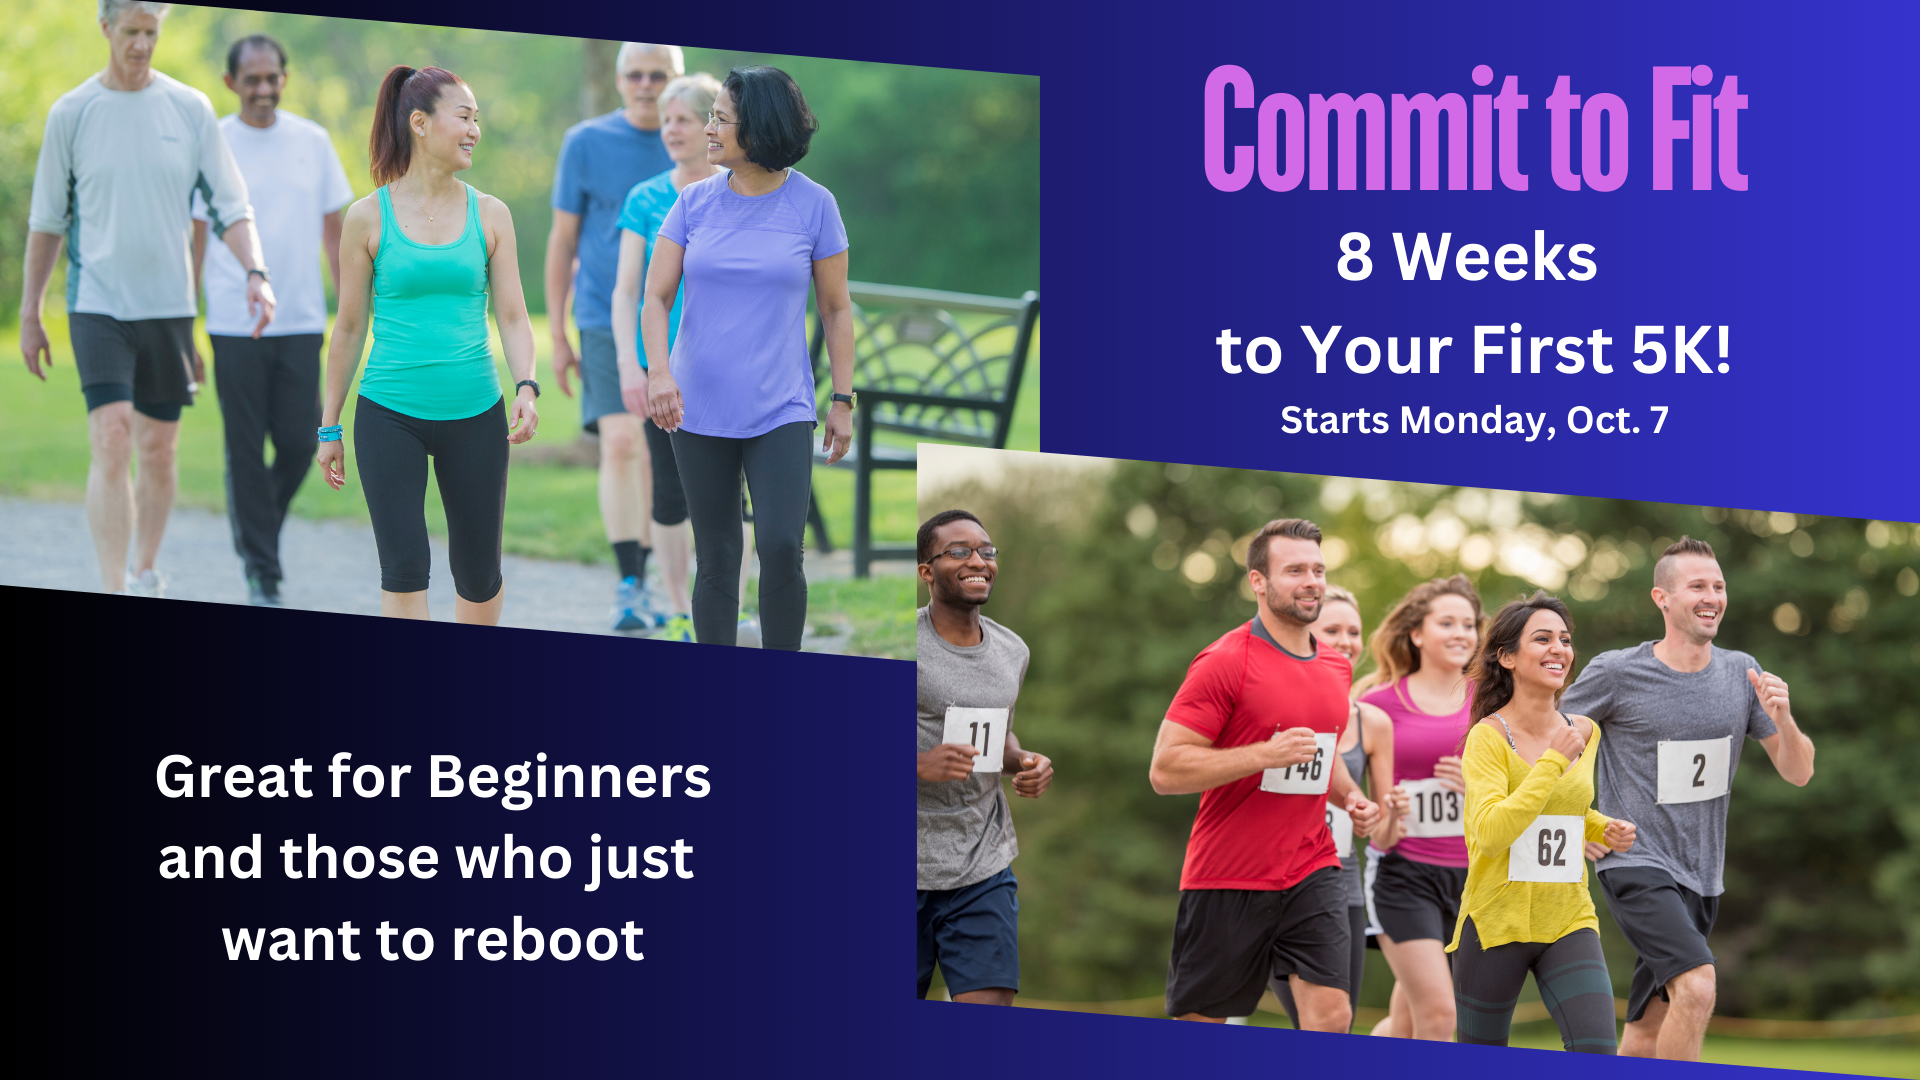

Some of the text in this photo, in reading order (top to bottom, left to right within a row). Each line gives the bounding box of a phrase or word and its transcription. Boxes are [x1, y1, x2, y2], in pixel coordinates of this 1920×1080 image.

[969, 721, 990, 757] 11
[1692, 753, 1706, 787] 2
[1415, 791, 1458, 823] 103
[1537, 828, 1567, 867] 62
